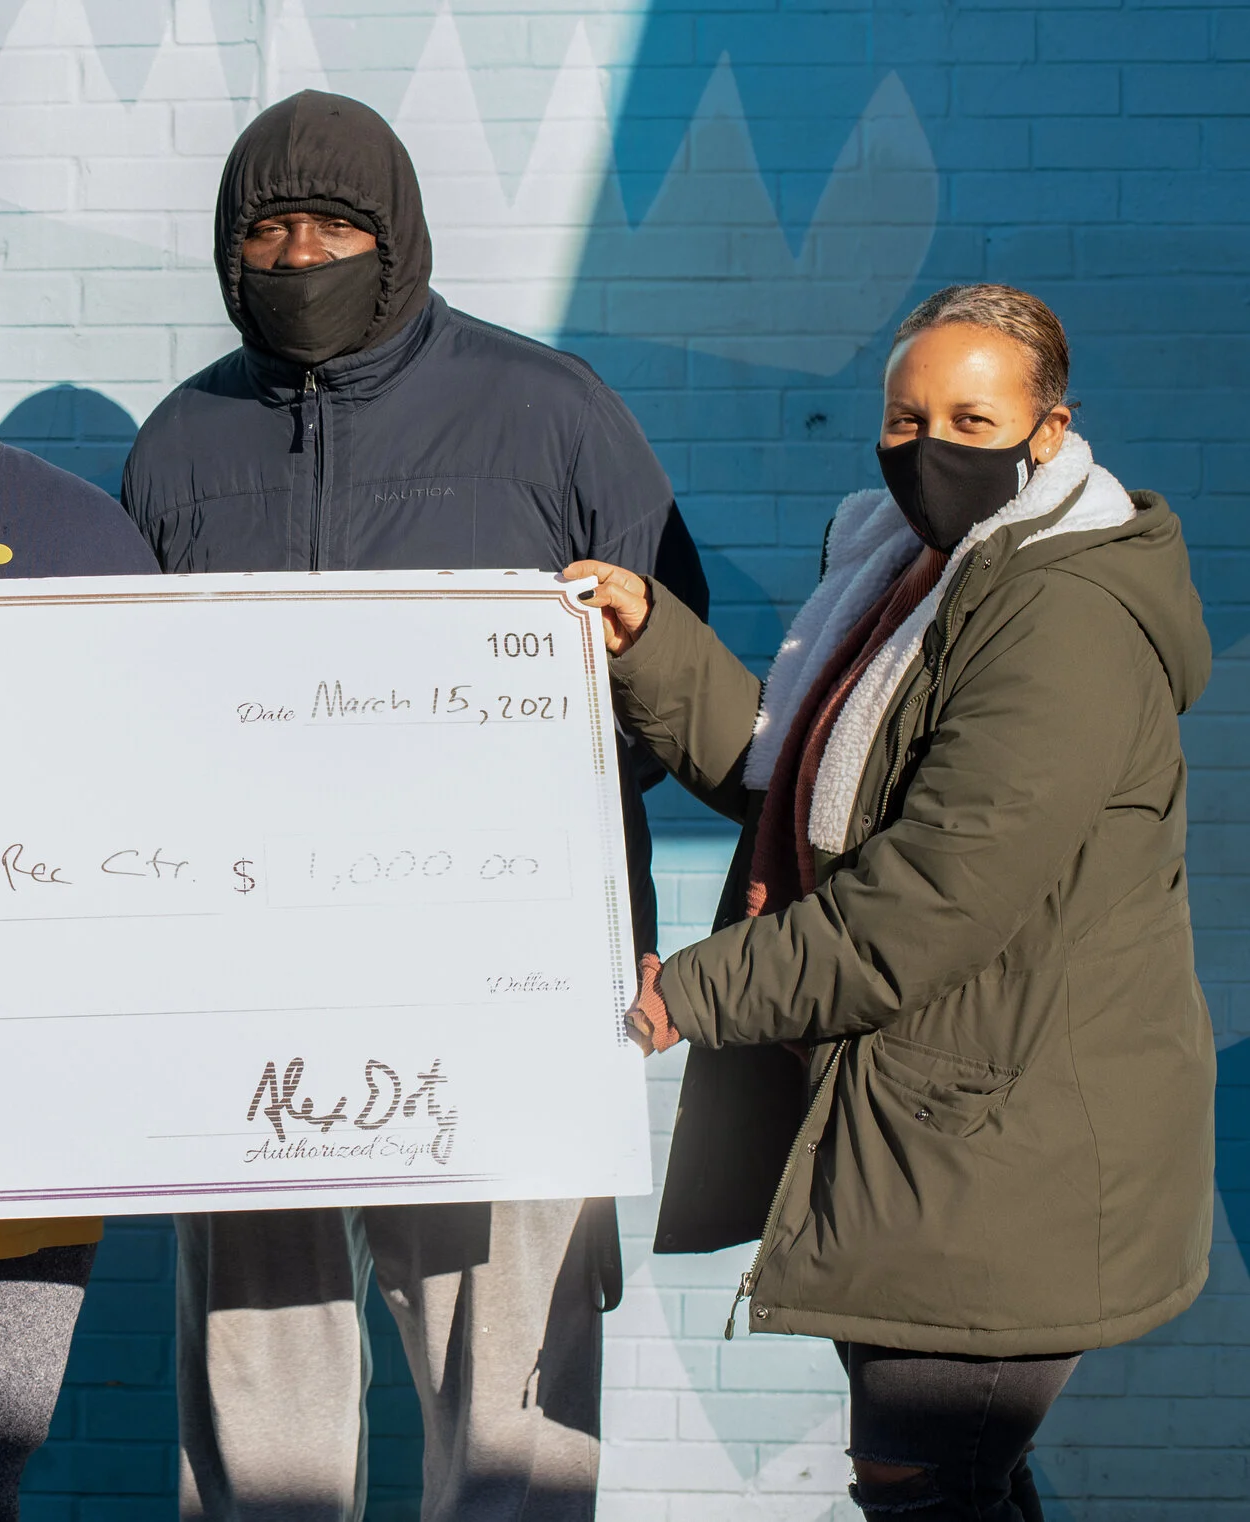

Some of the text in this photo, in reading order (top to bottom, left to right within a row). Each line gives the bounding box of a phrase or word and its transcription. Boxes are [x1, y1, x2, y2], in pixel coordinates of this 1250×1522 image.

[373, 487, 455, 504] NAUTICA
[487, 632, 555, 658] 1001
[237, 702, 296, 724] Date
[311, 680, 411, 719] March
[1, 844, 74, 891] Rec
[233, 857, 256, 895] $
[243, 1137, 383, 1164] Authorized
